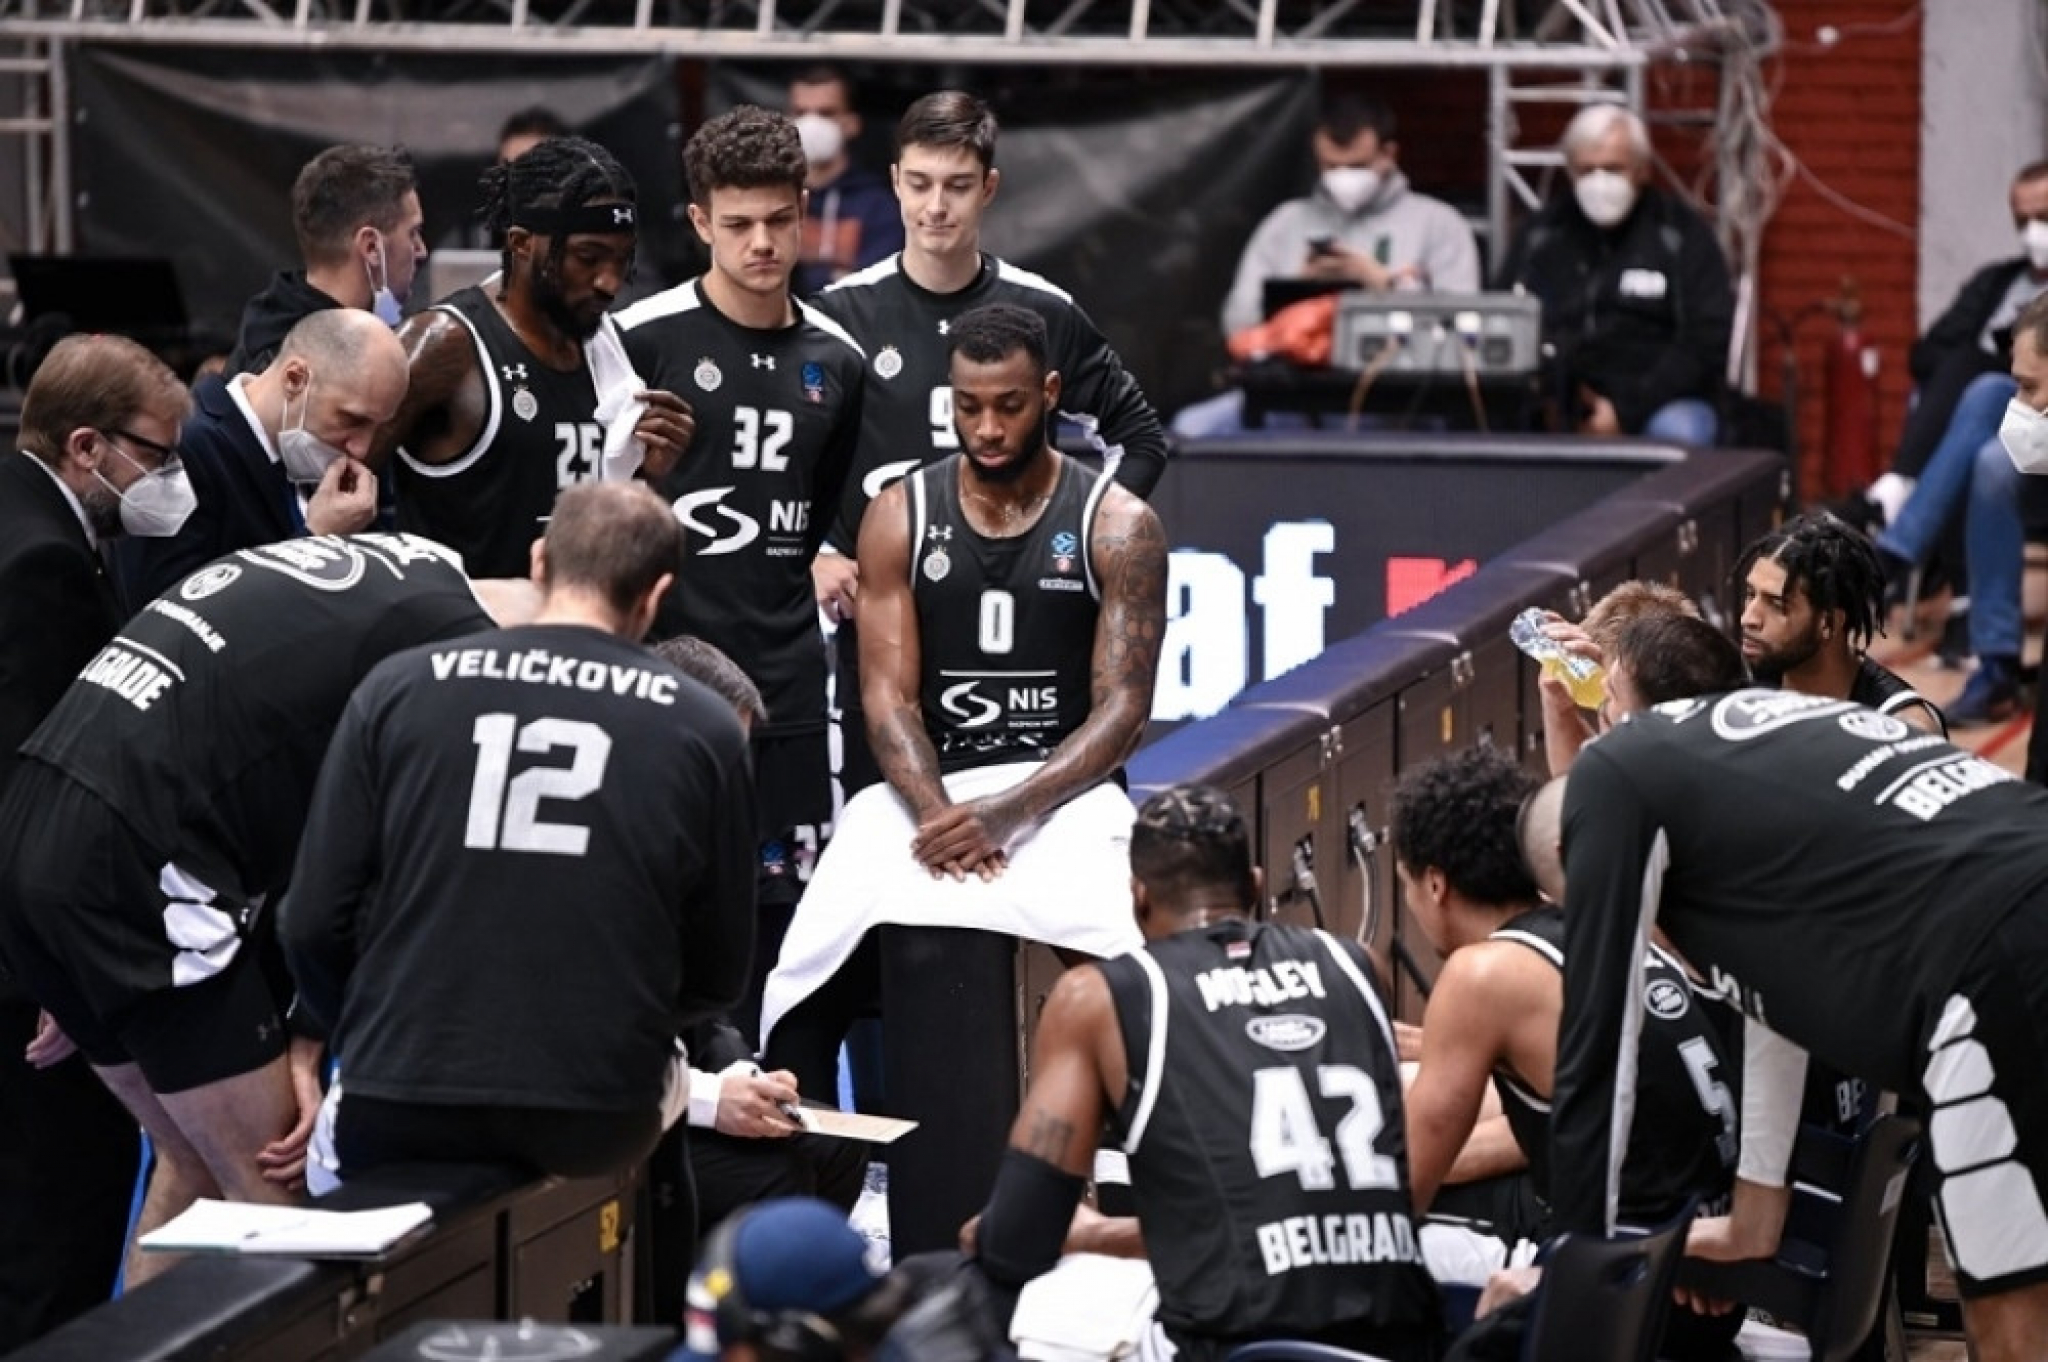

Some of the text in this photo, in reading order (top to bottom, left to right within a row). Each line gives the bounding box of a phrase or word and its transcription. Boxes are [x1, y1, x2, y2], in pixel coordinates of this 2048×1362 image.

[555, 422, 603, 490] 25
[731, 405, 794, 471] 32
[979, 589, 1015, 654] 0
[1008, 687, 1058, 711] NIS
[463, 711, 614, 857] 12
[1249, 1065, 1400, 1192] 42
